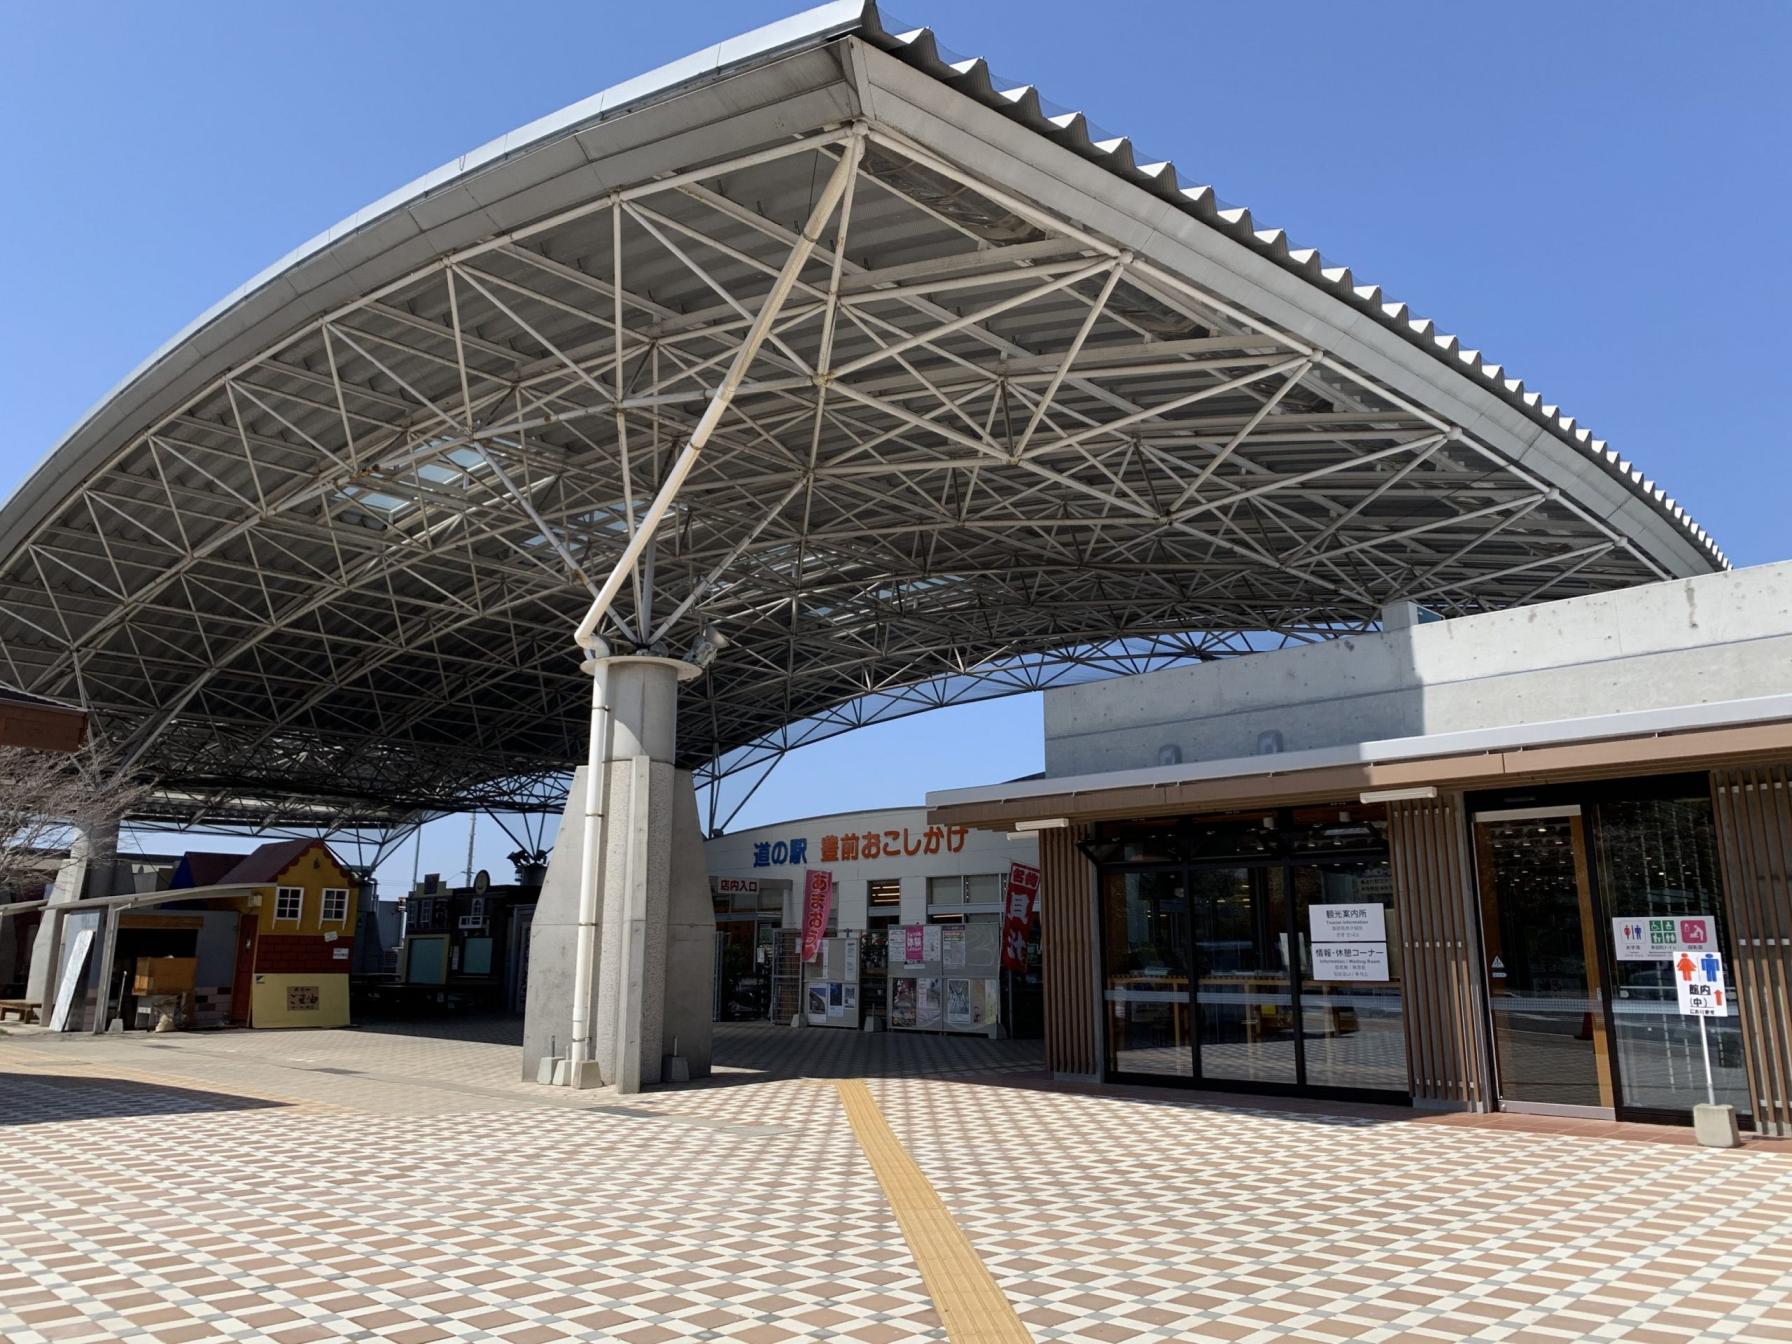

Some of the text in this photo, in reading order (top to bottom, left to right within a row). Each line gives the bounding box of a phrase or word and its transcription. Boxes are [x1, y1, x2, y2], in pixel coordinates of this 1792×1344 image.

[753, 825, 969, 868] 道の駅 豊前おこしかけ
[1013, 868, 1039, 888] 名物
[720, 879, 758, 892] 店内入口
[806, 872, 828, 946] あまおう
[1326, 909, 1367, 919] 観光案内所
[1316, 948, 1384, 958] 情報・休憩コーナー
[1689, 984, 1711, 995] 館内
[1690, 998, 1708, 1007] (中)
